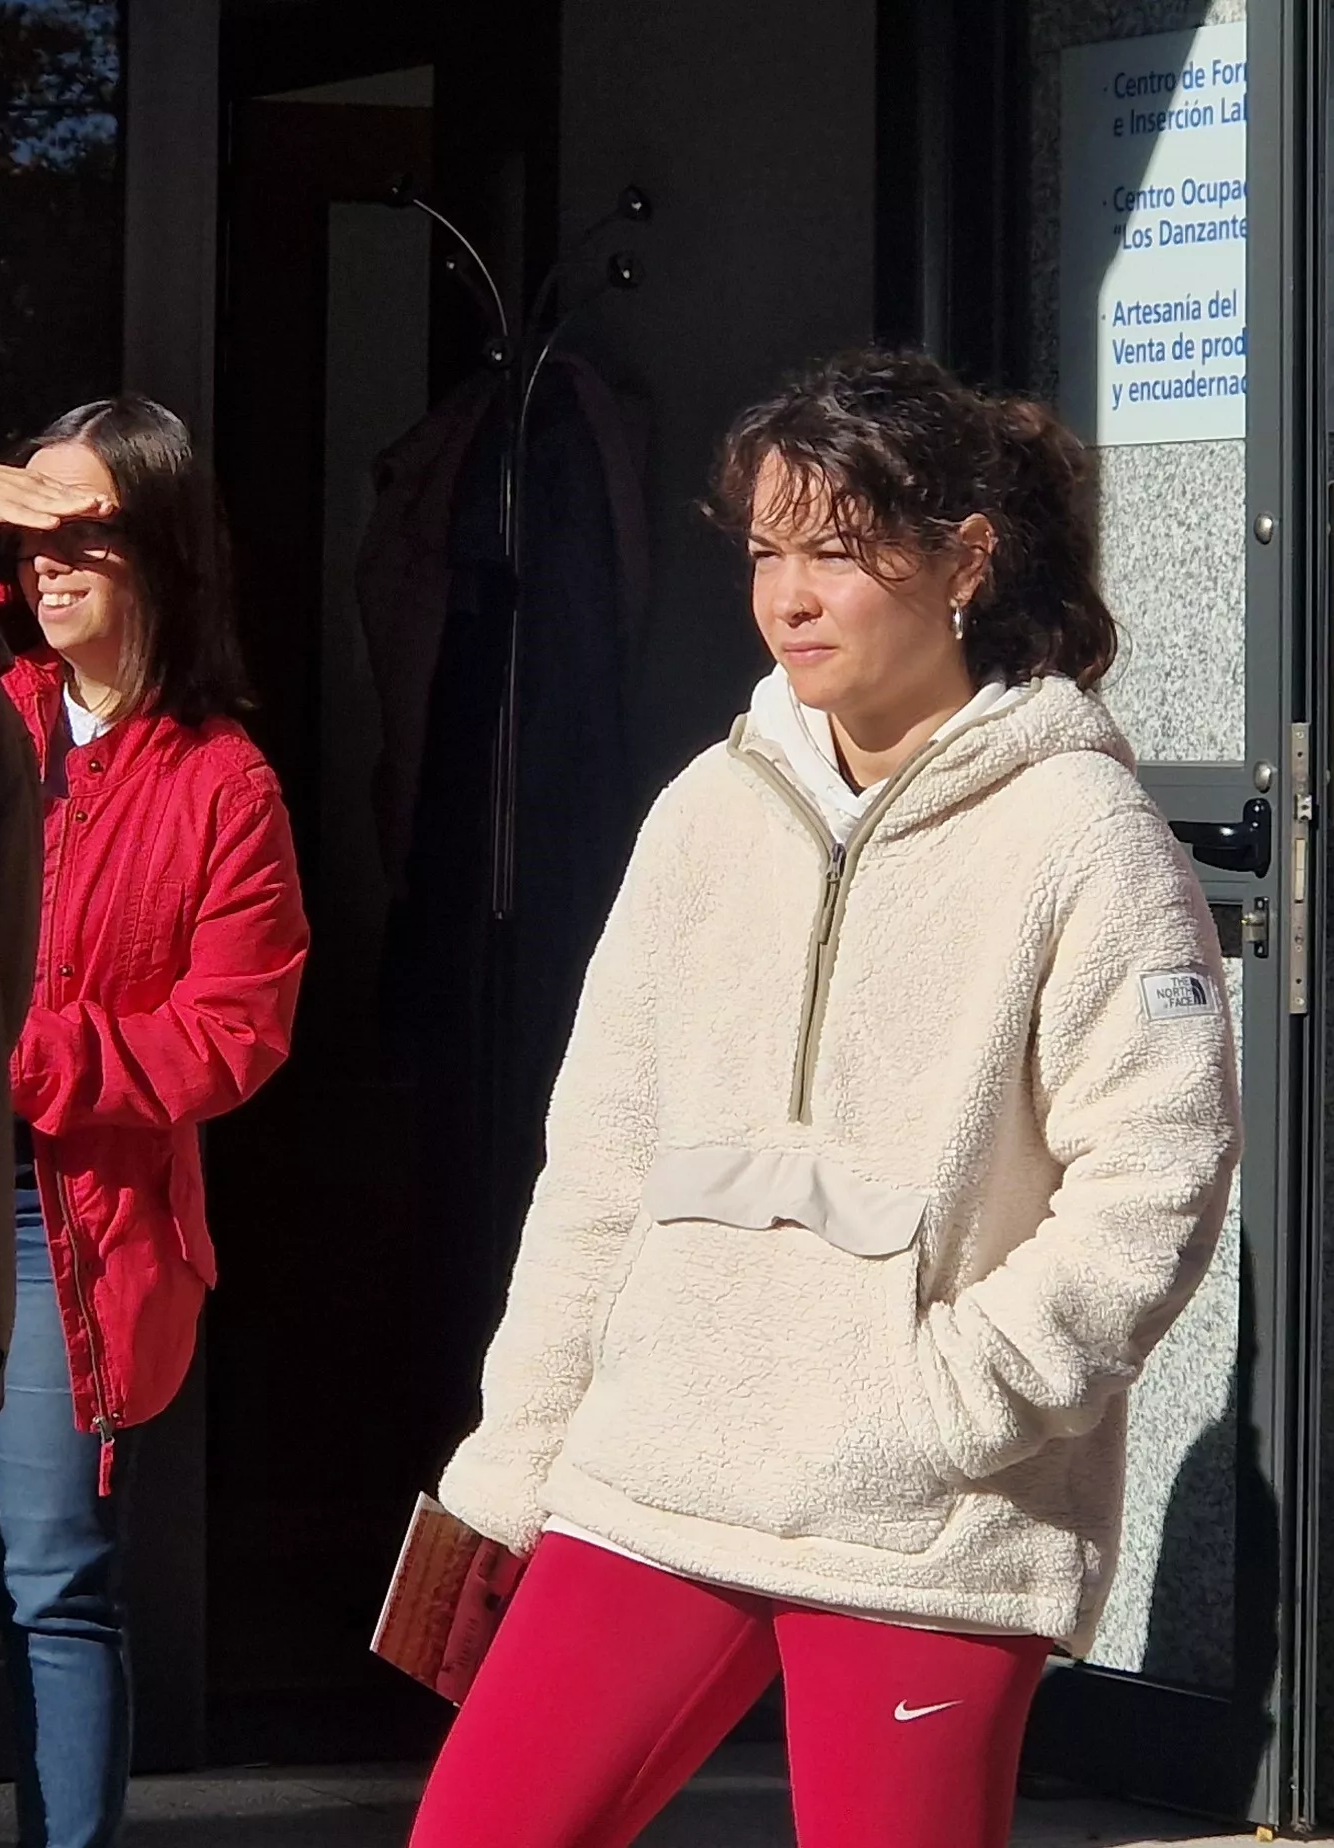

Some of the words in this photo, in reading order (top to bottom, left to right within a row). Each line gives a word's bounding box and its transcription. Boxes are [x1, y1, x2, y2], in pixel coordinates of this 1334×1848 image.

[1114, 70, 1176, 98] Centro
[1182, 61, 1205, 90] de
[1113, 116, 1124, 137] e
[1130, 99, 1214, 135] Inserción
[1113, 184, 1175, 212] Centro
[1112, 293, 1202, 327] Artesanía
[1208, 288, 1237, 319] del
[1112, 338, 1166, 365] Venta
[1172, 331, 1195, 361] de
[1201, 326, 1248, 366] prod
[1112, 383, 1123, 411] y
[1156, 986, 1193, 999] NORTH
[1170, 976, 1191, 987] THE
[1169, 997, 1195, 1008] FACE
